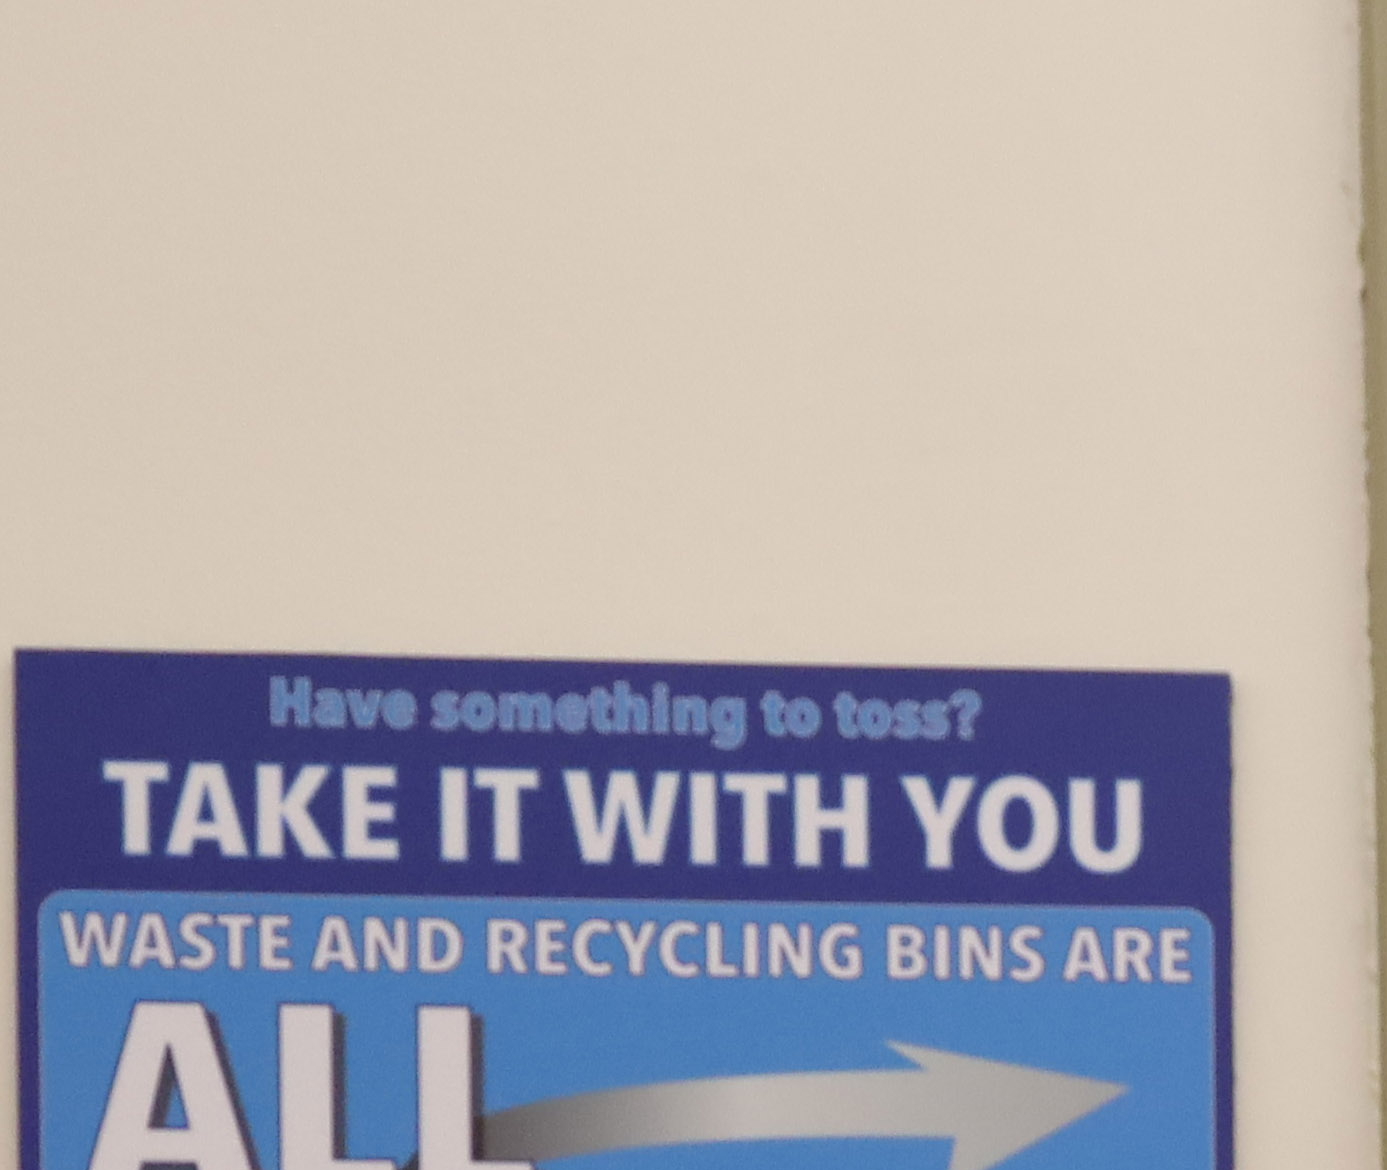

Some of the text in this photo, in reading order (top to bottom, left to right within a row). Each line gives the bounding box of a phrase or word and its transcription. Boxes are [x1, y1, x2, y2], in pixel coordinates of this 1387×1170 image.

[269, 676, 983, 750] Have something to toss?
[103, 760, 1143, 875] TAKE IT WITH YOU
[58, 911, 1194, 984] WASTE AND RECYCLING BINS ARE
